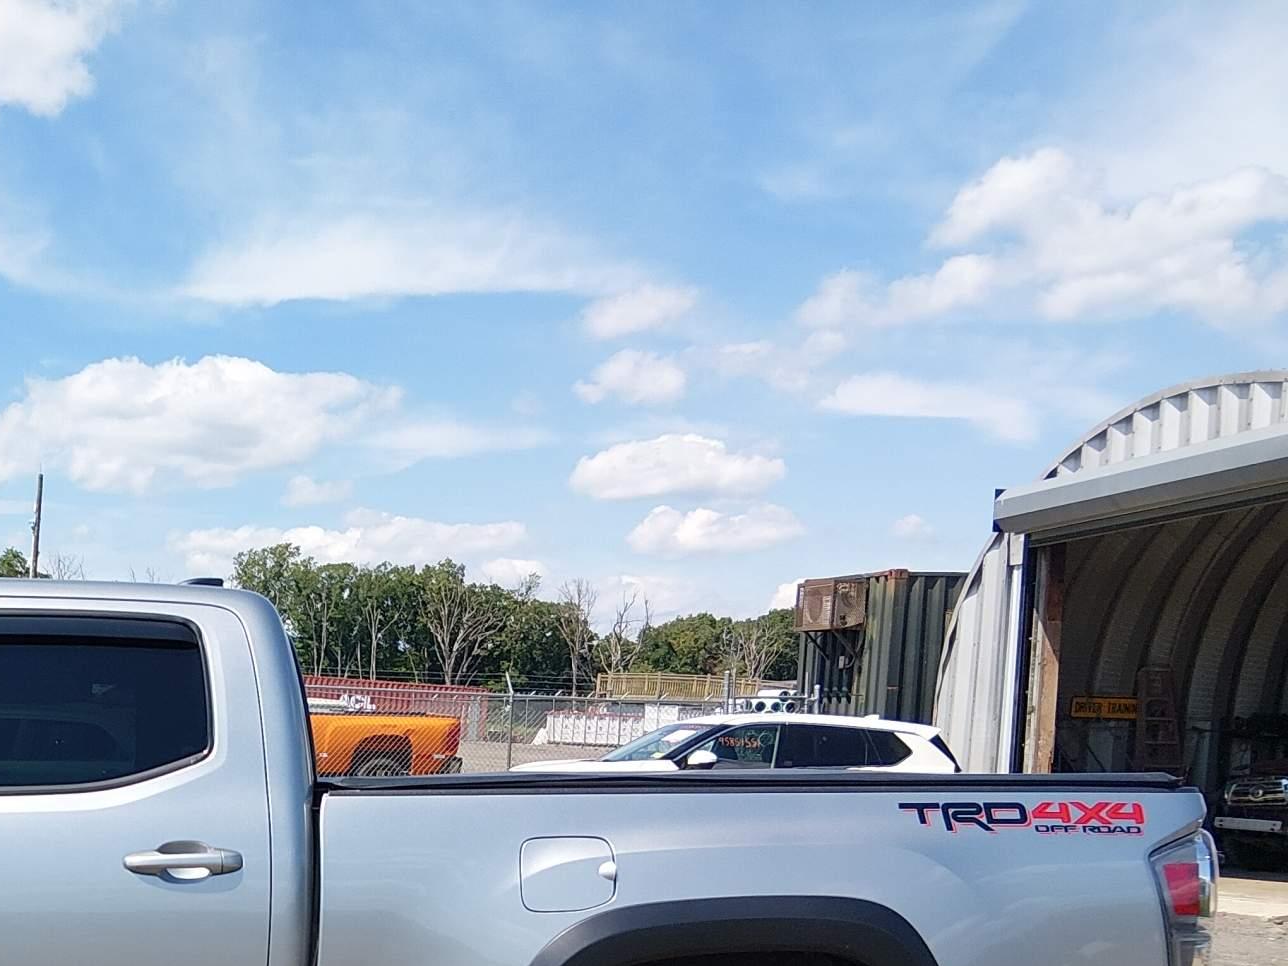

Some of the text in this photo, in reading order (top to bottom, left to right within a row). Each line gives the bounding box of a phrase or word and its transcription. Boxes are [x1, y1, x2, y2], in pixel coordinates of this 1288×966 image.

[1075, 702, 1140, 714] DRIVER TRAININ
[898, 802, 1032, 833] TRD
[1034, 824, 1143, 834] OFF ROAD
